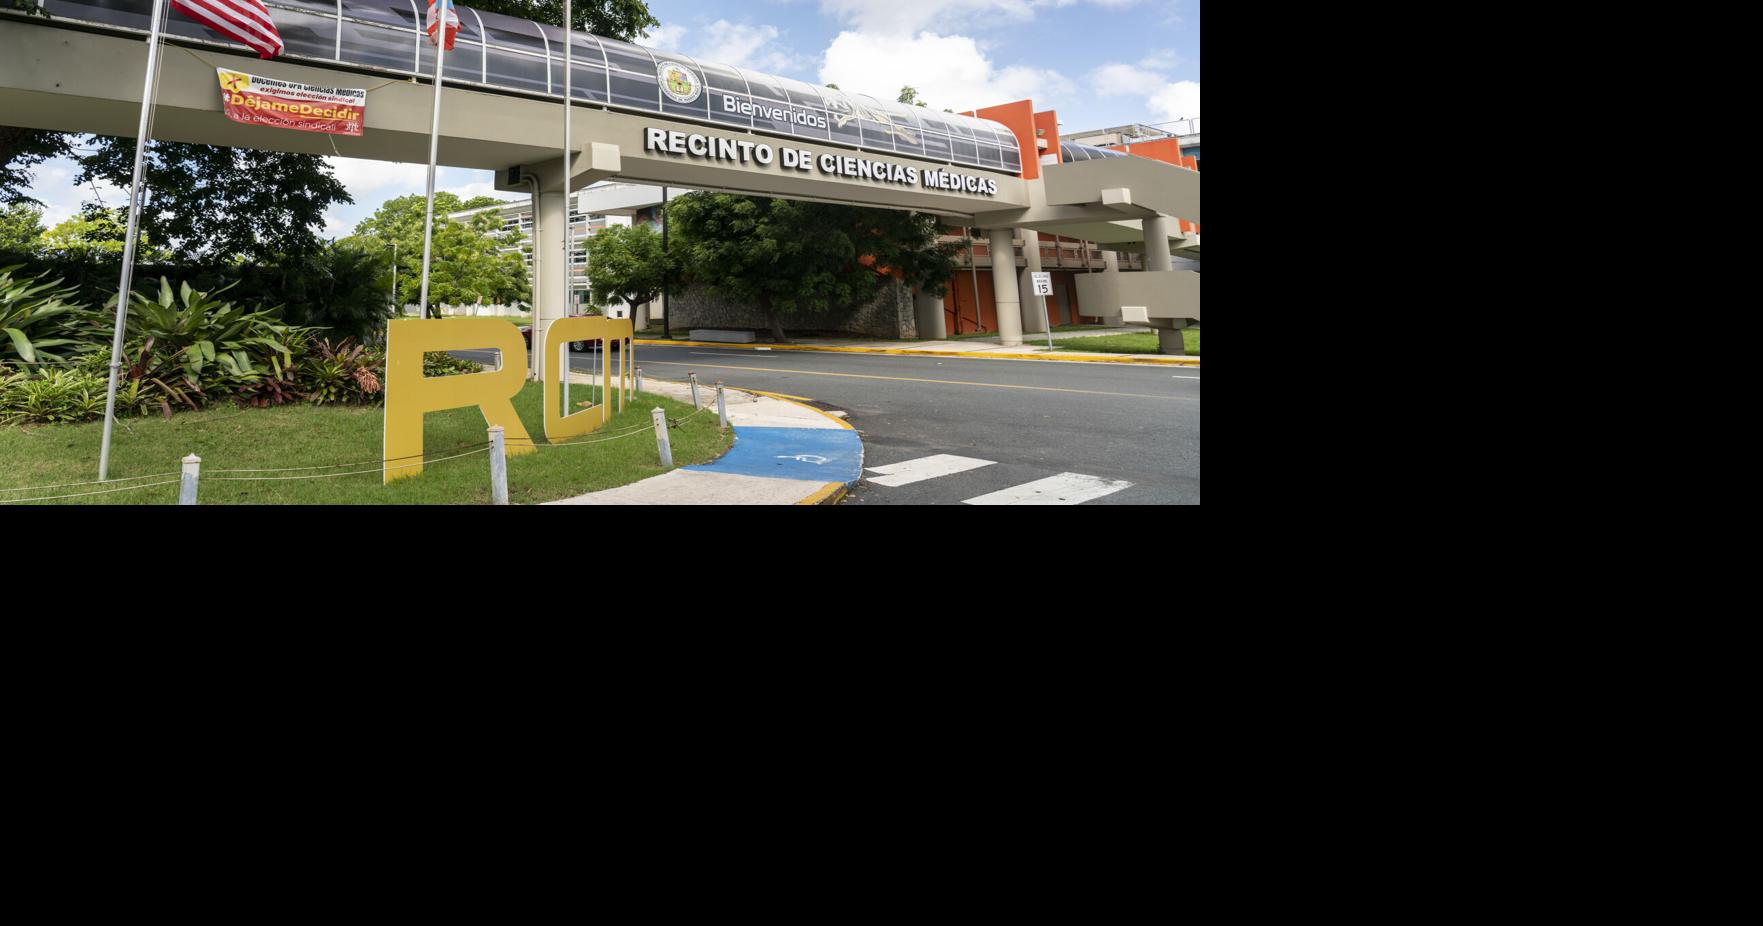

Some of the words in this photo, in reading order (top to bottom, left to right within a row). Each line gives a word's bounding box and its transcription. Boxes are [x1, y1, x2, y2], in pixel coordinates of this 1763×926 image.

[260, 87, 295, 97] exigimos
[241, 112, 251, 121] la
[722, 95, 827, 129] Bienvenidos
[645, 127, 774, 164] RECINTO
[781, 147, 813, 170] DE
[818, 153, 919, 184] CIENCIAS
[923, 168, 998, 195] MÉDICAS
[1038, 284, 1049, 294] 15
